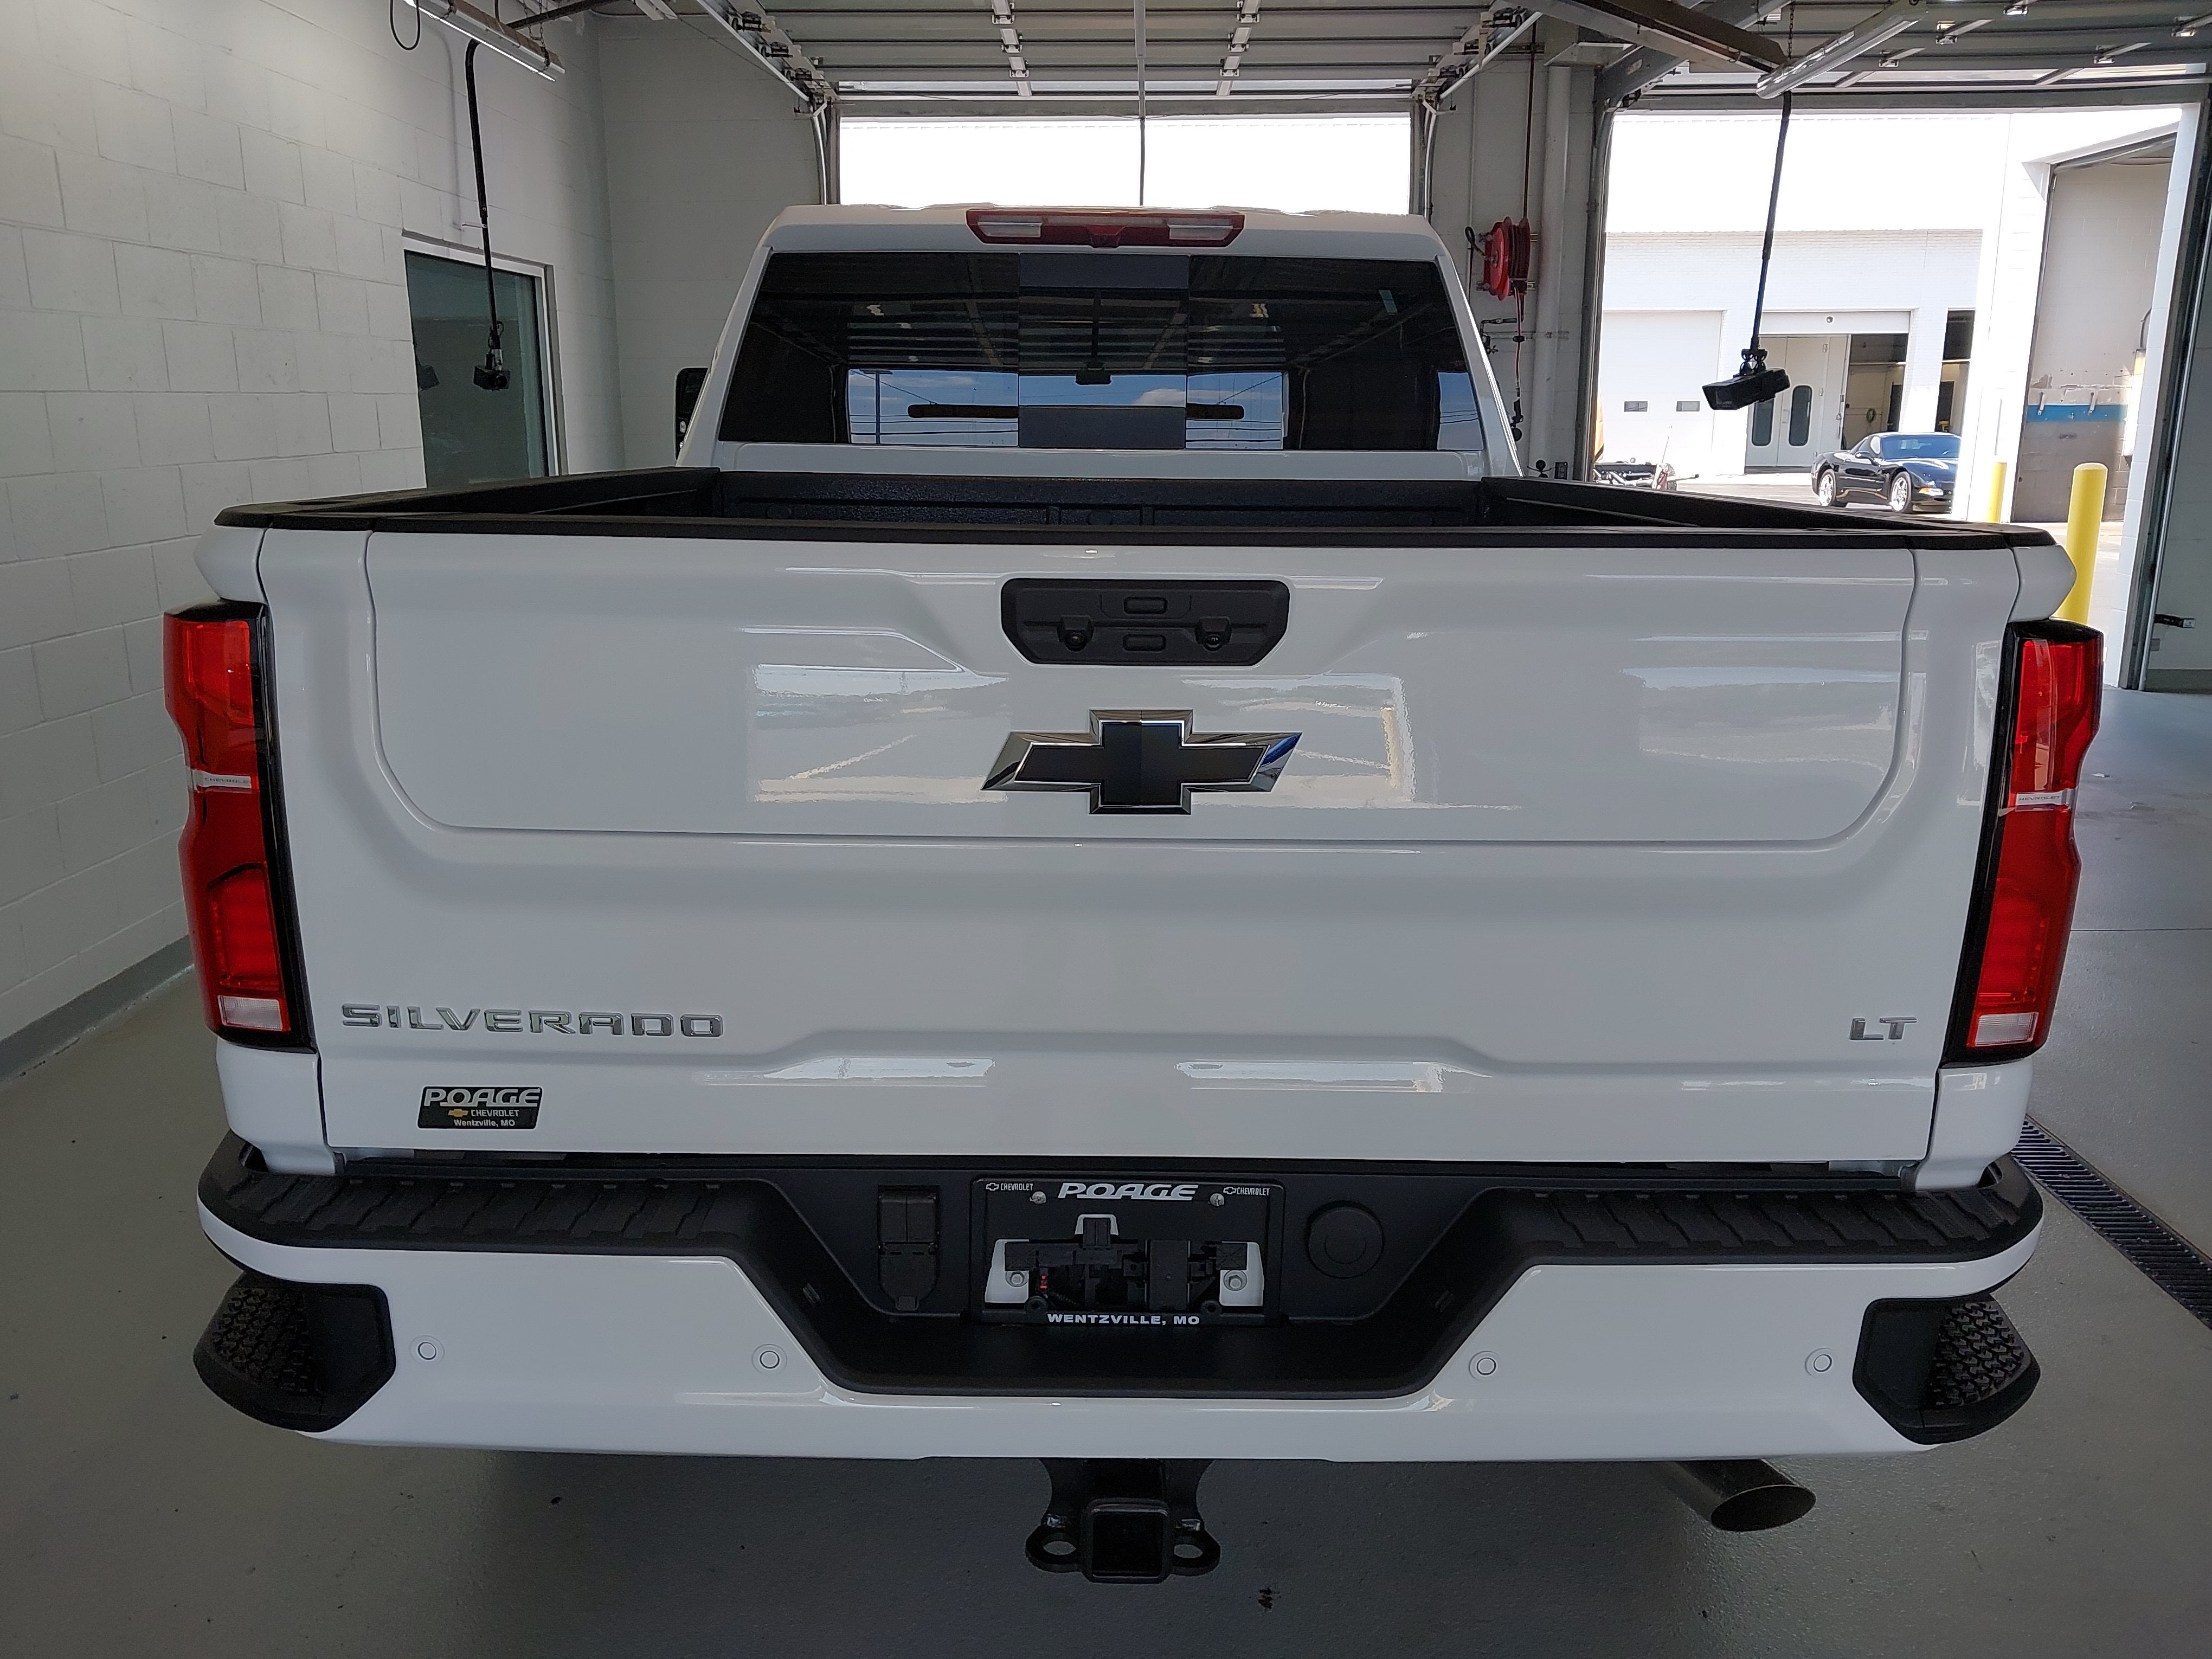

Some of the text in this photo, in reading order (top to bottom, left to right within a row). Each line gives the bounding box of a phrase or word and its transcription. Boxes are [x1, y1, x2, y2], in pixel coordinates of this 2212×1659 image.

[342, 1003, 724, 1037] SILVERADO
[1849, 1017, 1918, 1040] LT
[423, 1088, 541, 1107] POAGE
[471, 1109, 519, 1117] CHEVROLET
[454, 1119, 499, 1128] Wentzville,
[1000, 1183, 1034, 1191] CHEVROLET
[1058, 1182, 1199, 1201] POAGE
[1236, 1187, 1270, 1196] CHEVROLET
[1047, 1313, 1200, 1326] WENTZVILLE, MO
